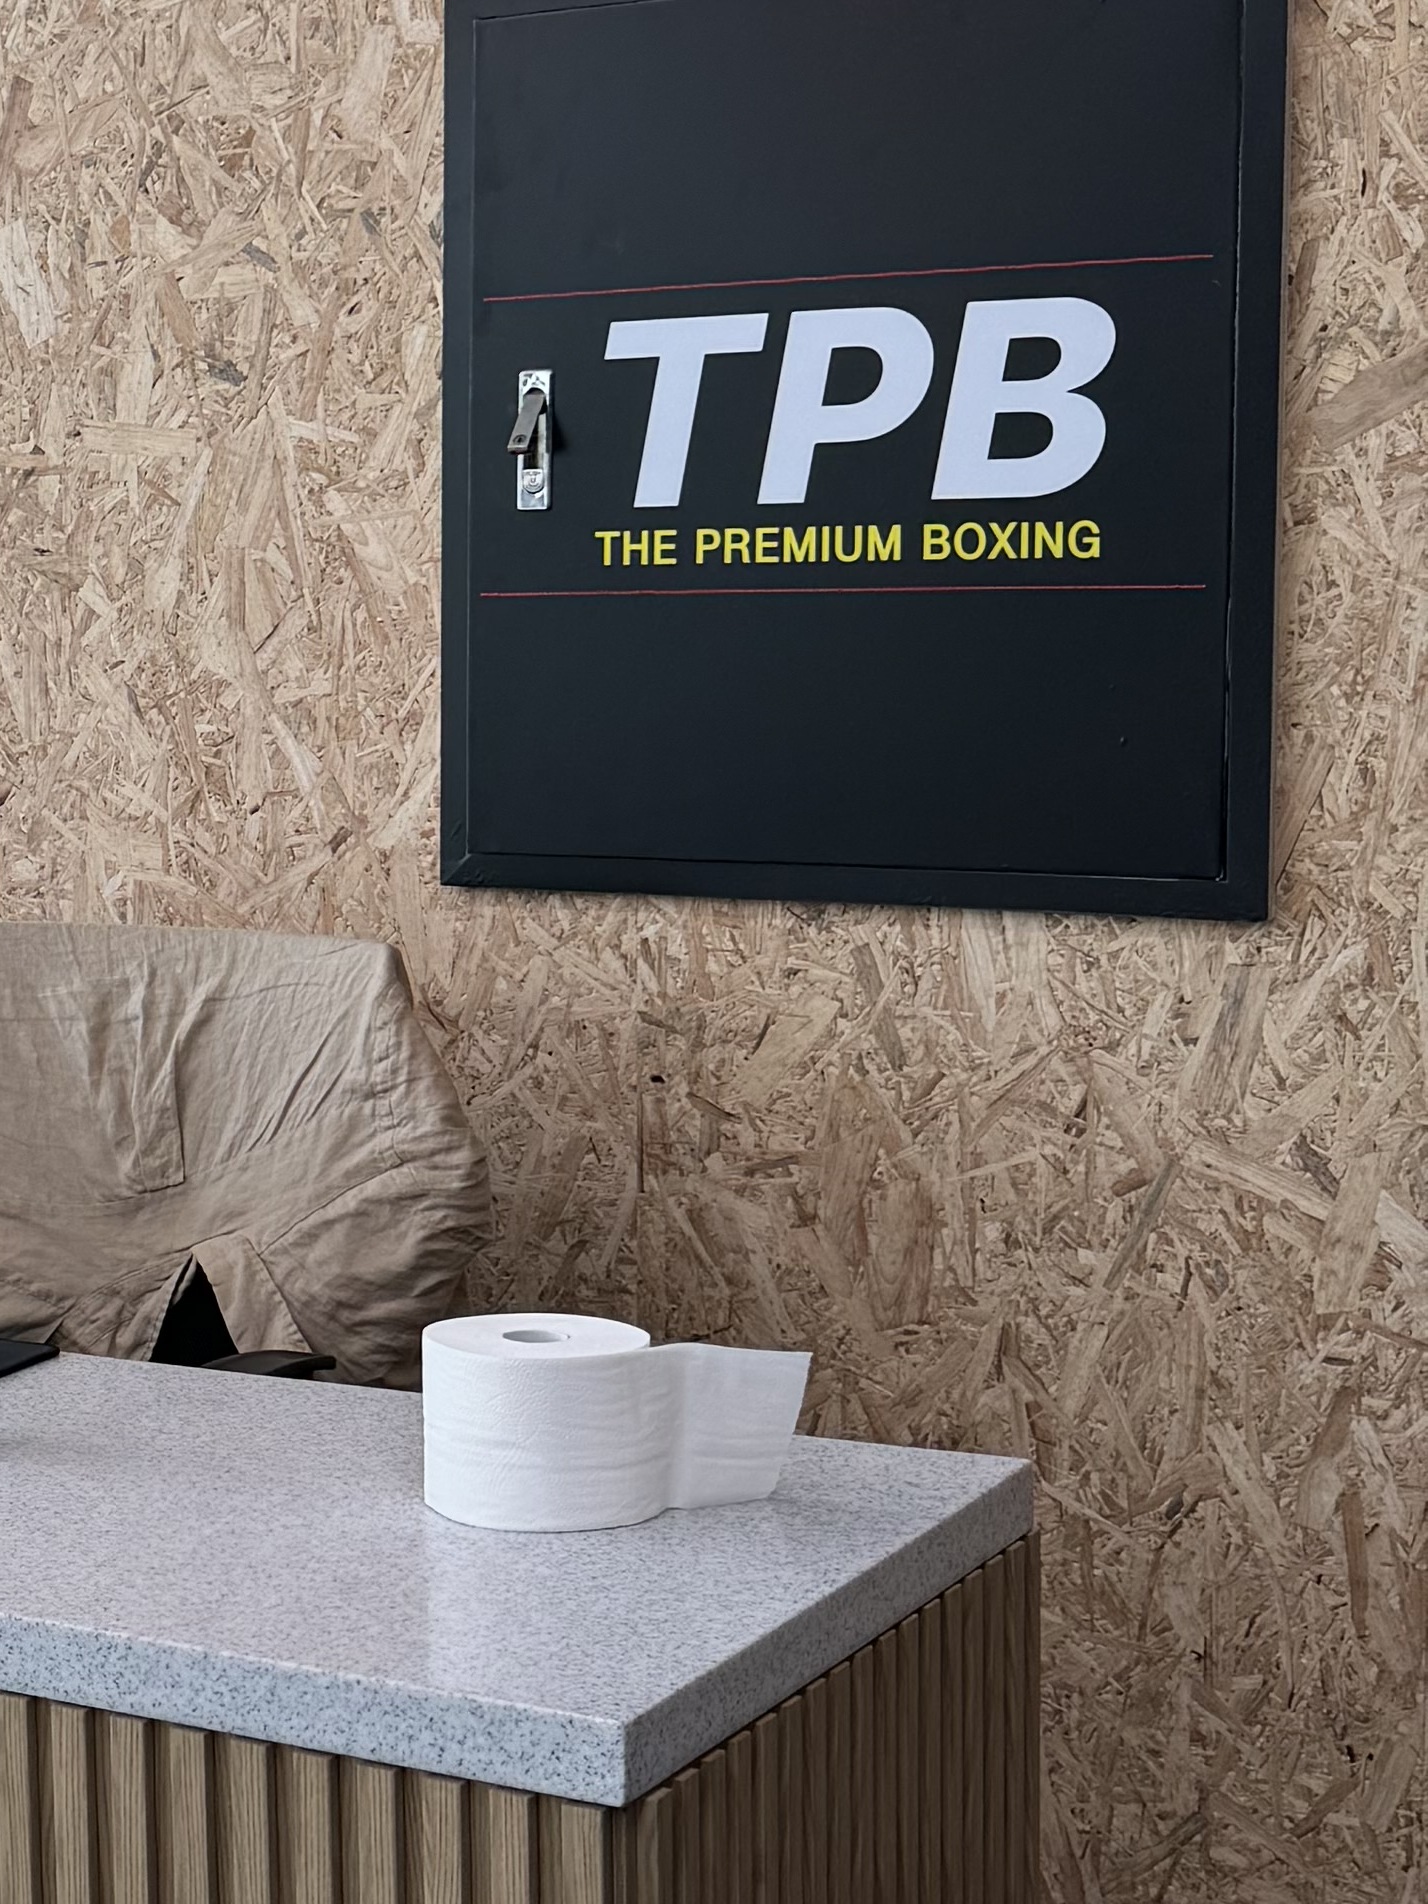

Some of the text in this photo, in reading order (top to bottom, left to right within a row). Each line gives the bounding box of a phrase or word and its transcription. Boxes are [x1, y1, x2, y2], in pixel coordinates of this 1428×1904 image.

[603, 296, 1117, 508] TPB
[594, 519, 1101, 567] THE PREMIUM BOXING
